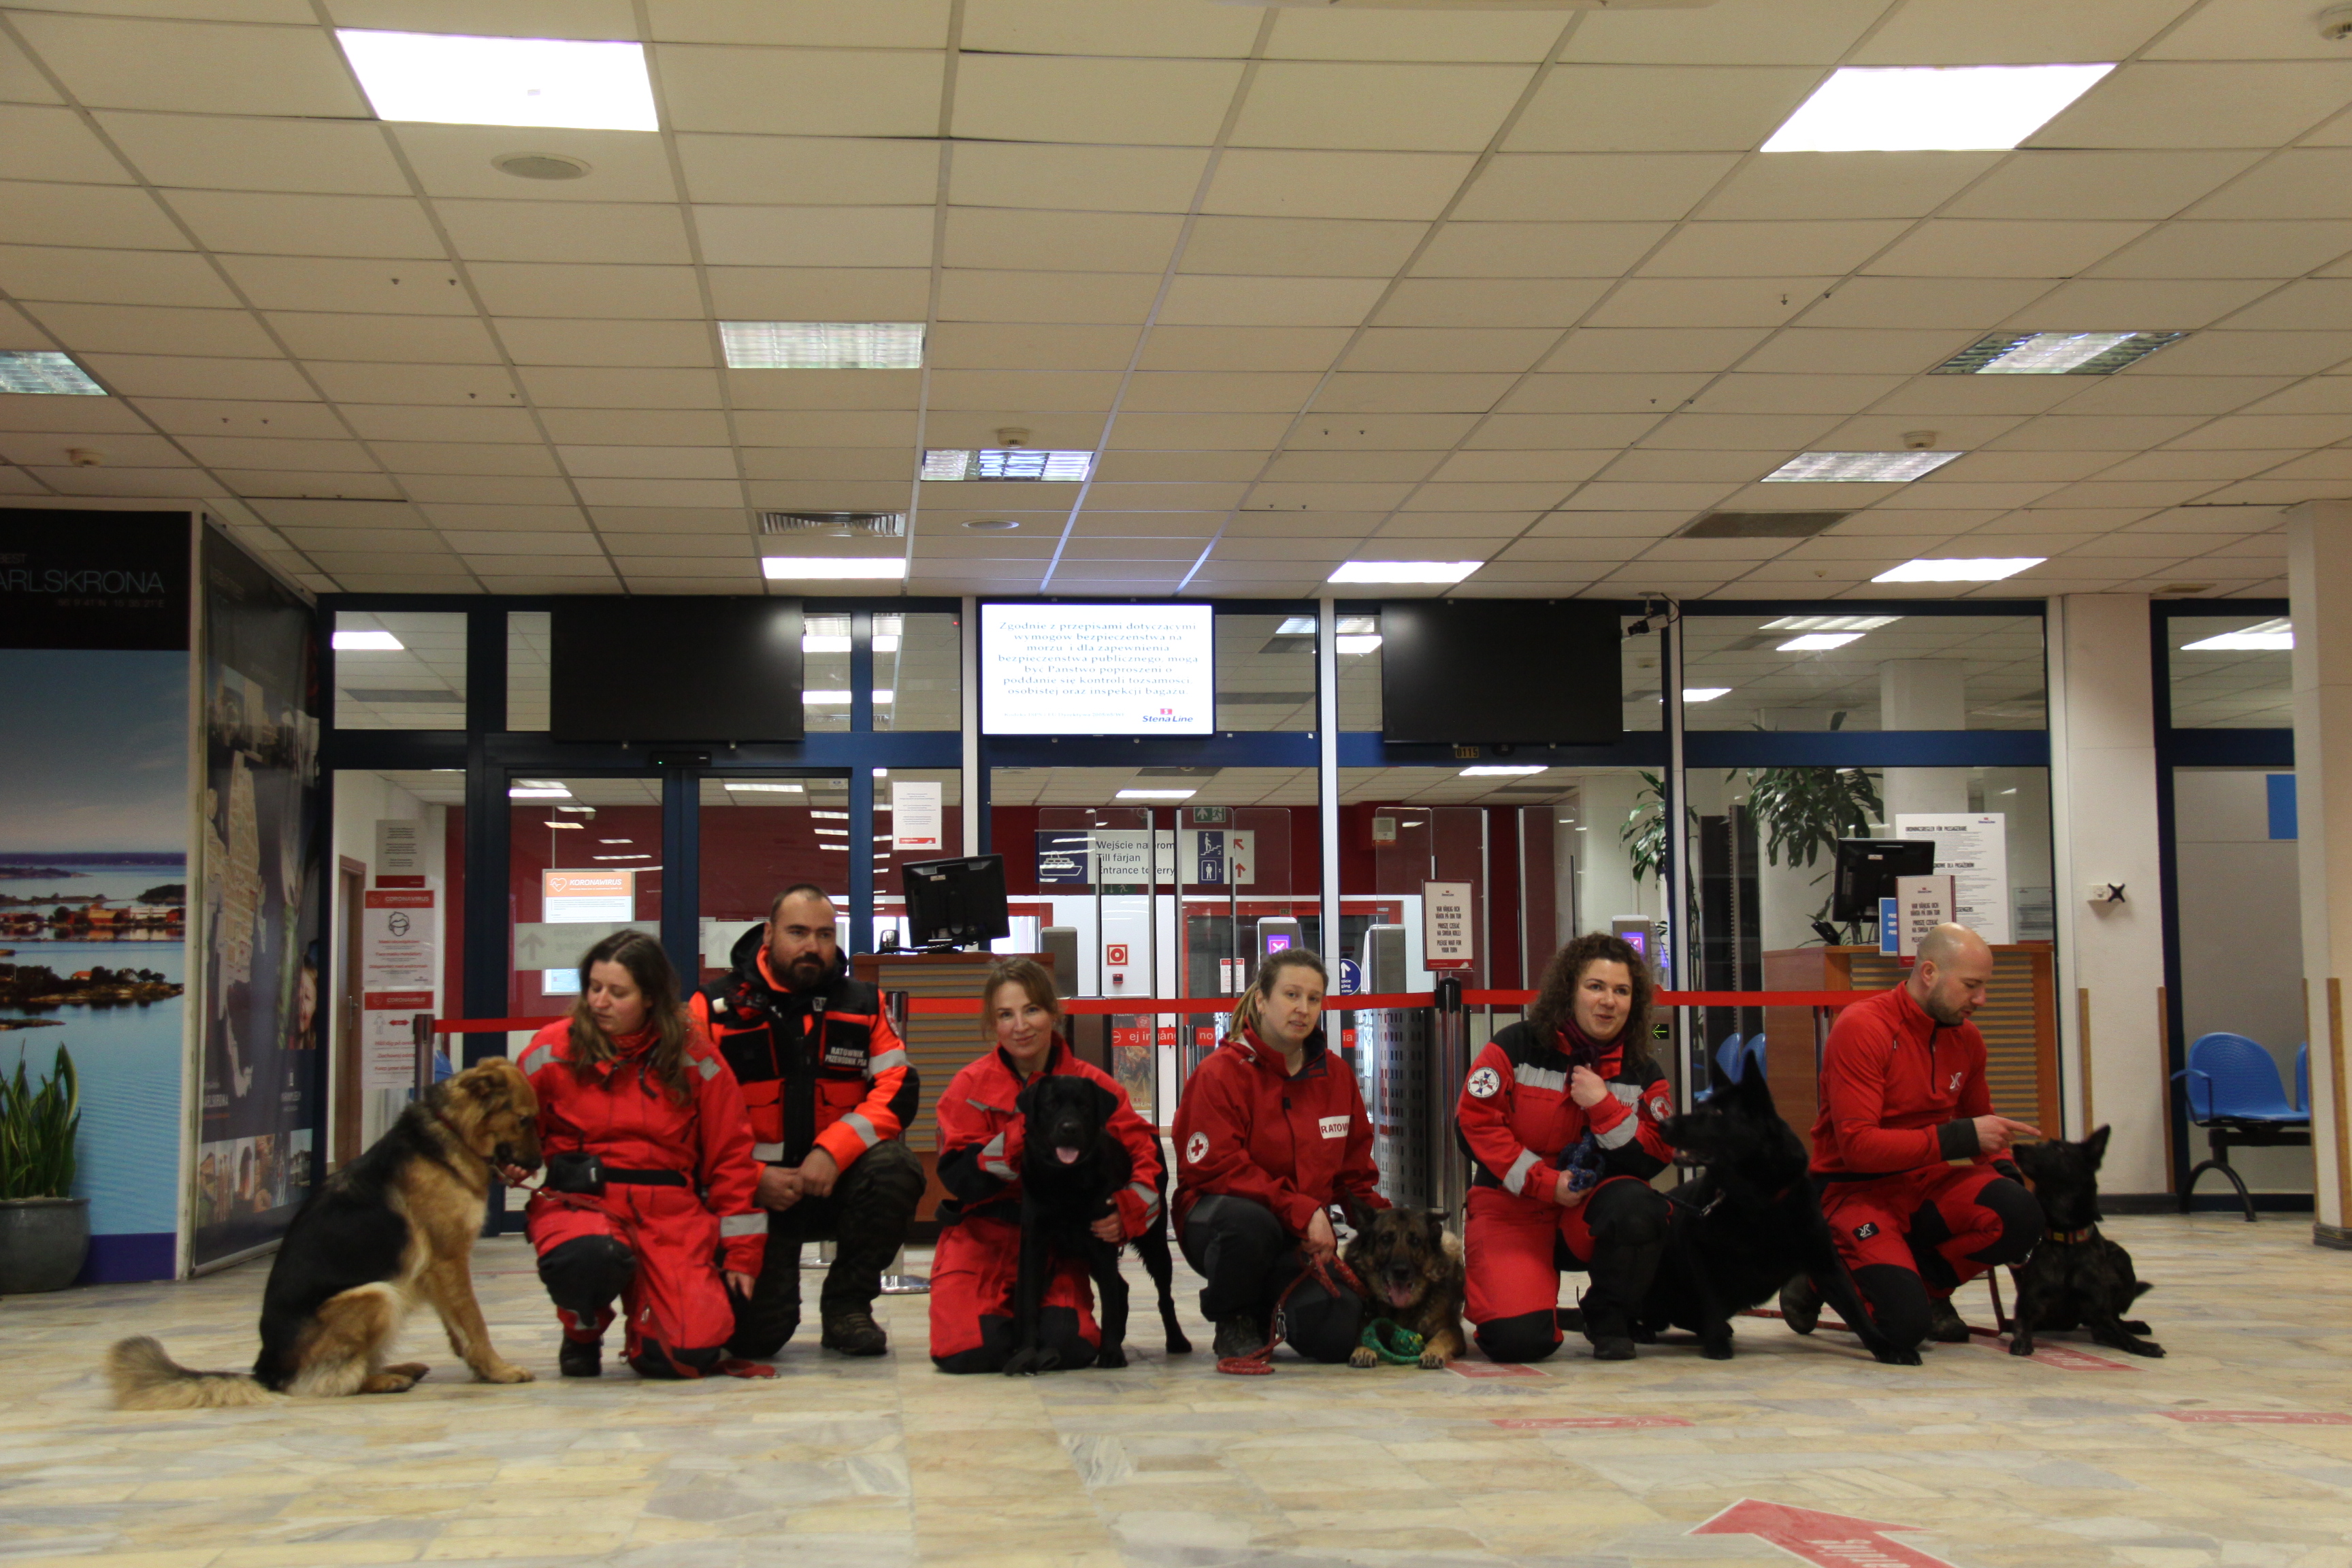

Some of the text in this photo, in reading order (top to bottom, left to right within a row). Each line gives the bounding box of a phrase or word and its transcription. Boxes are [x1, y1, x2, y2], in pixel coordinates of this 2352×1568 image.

[999, 621, 1047, 631] Zgodnie
[1060, 621, 1123, 632] przepisami
[1077, 643, 1094, 651] dla
[1098, 644, 1169, 653] zapewnienia
[1099, 666, 1162, 674] poproszeni
[1003, 676, 1056, 685] poddanie
[1079, 676, 1125, 684] kontroli
[1008, 687, 1058, 696] osobistej
[1090, 687, 1142, 696] inspekcji
[1456, 748, 1478, 757] 0115
[1096, 840, 1133, 851] Wejście
[1097, 853, 1141, 863] Till färjan
[1155, 867, 1175, 876] erry
[1129, 1031, 1139, 1043] ej
[830, 1047, 864, 1058] RATOWNIK
